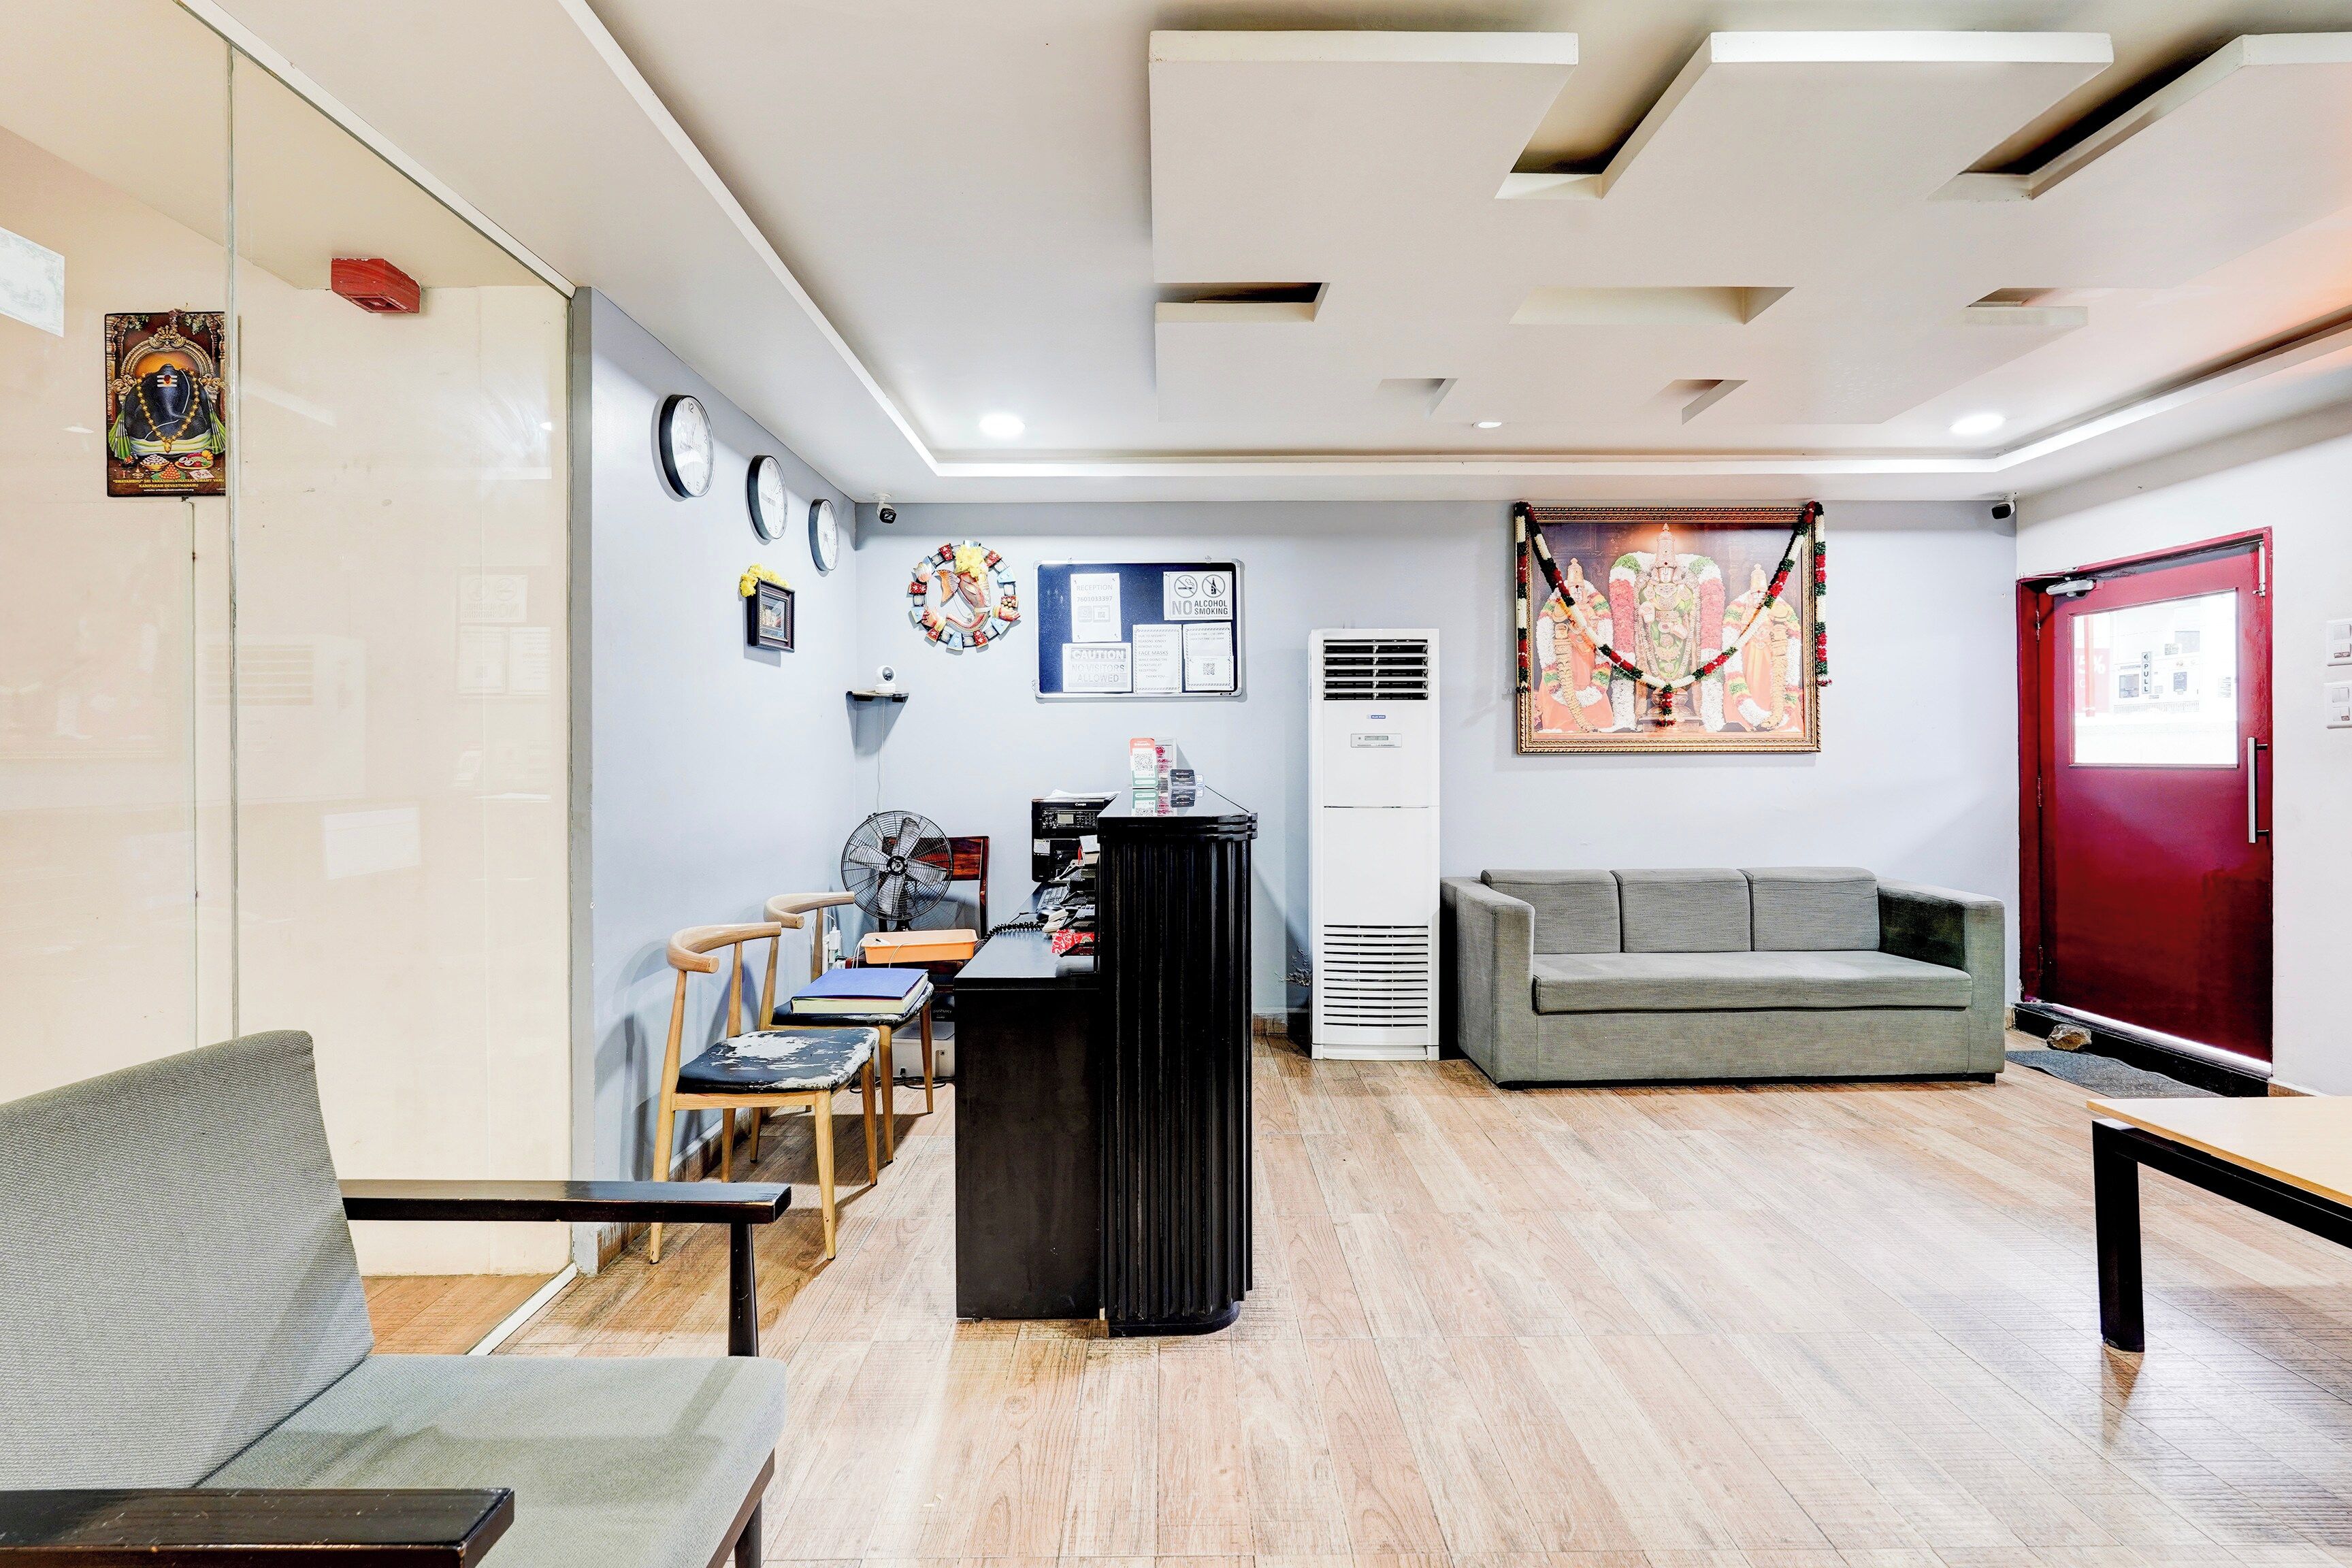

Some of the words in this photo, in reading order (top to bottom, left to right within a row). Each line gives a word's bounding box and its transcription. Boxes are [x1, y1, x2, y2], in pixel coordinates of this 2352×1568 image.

[687, 402, 694, 414] 12
[1172, 600, 1192, 615] NO
[1194, 600, 1228, 608] ALCOHOL
[1072, 651, 1124, 659] CAUTION
[1086, 664, 1125, 672] VISITORS
[1077, 674, 1119, 683] ALLOWED
